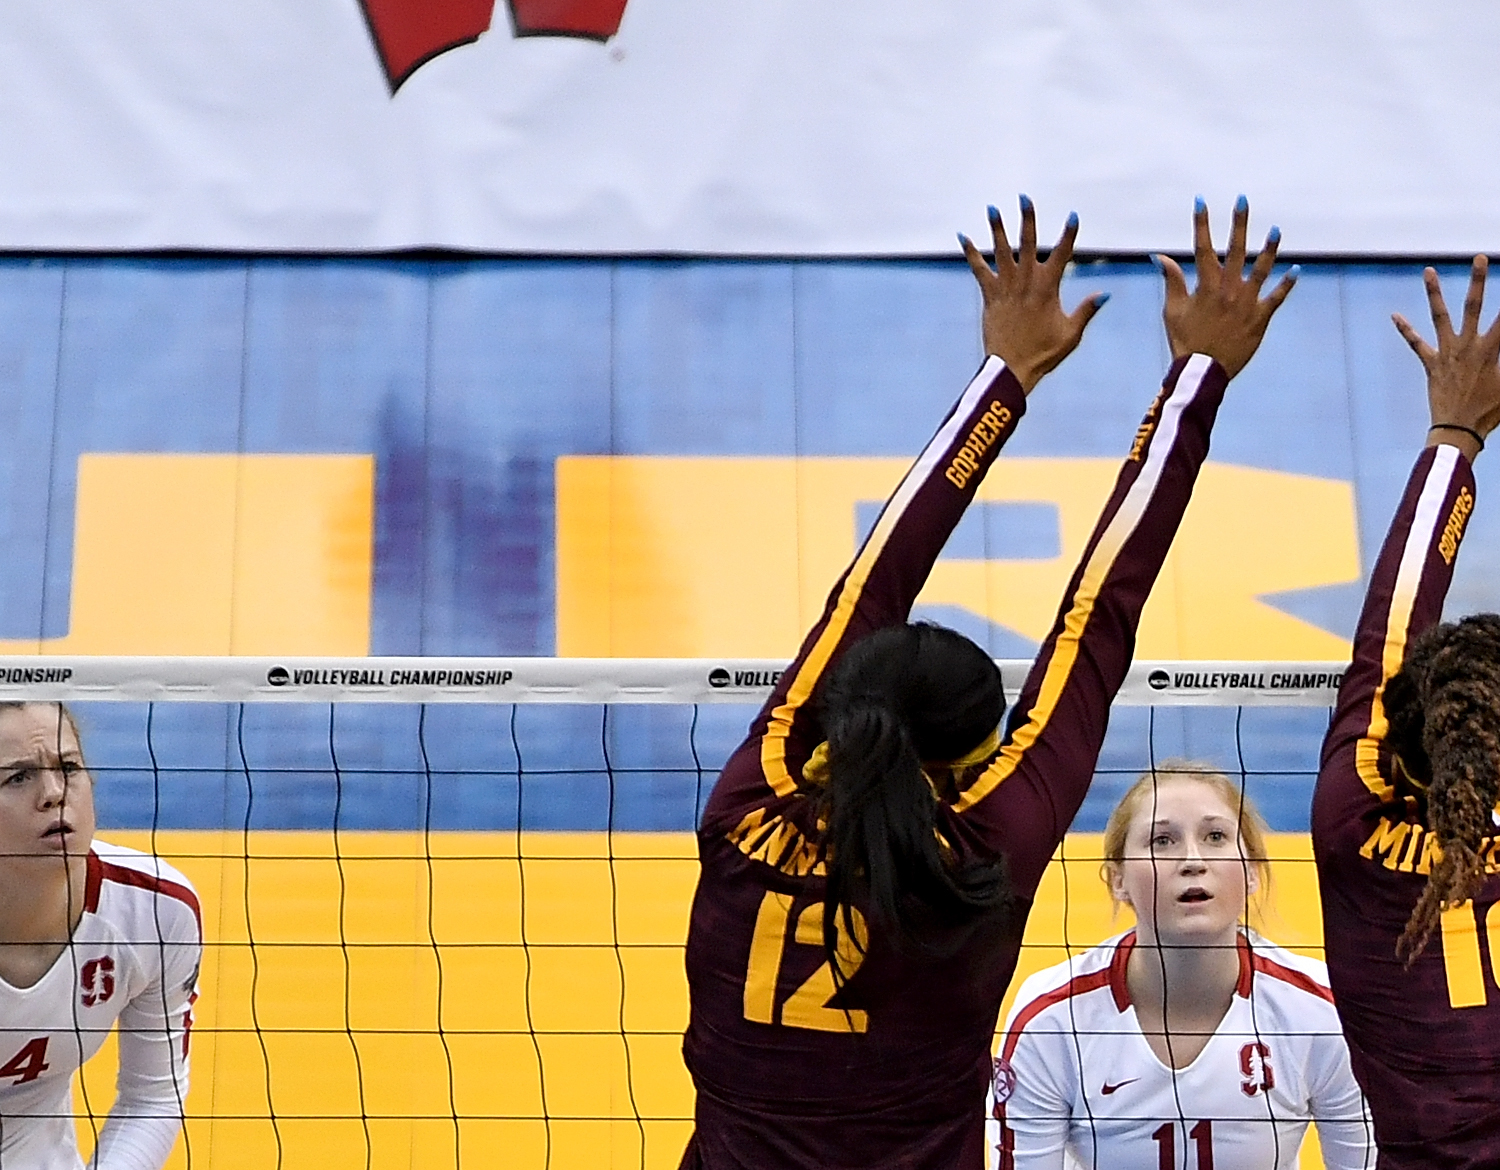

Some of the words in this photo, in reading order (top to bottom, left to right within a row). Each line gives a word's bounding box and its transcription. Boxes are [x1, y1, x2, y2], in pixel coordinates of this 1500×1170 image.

[945, 400, 1012, 489] GOPHERS
[1438, 486, 1473, 566] GOPHERS
[293, 669, 386, 685] VOLLEYBALL
[390, 670, 513, 685] CHAMPIONSHIP
[734, 671, 785, 686] VOLLE
[1174, 672, 1266, 688] VOLLEYBALL
[743, 890, 869, 1033] 12
[0, 1036, 50, 1086] 4
